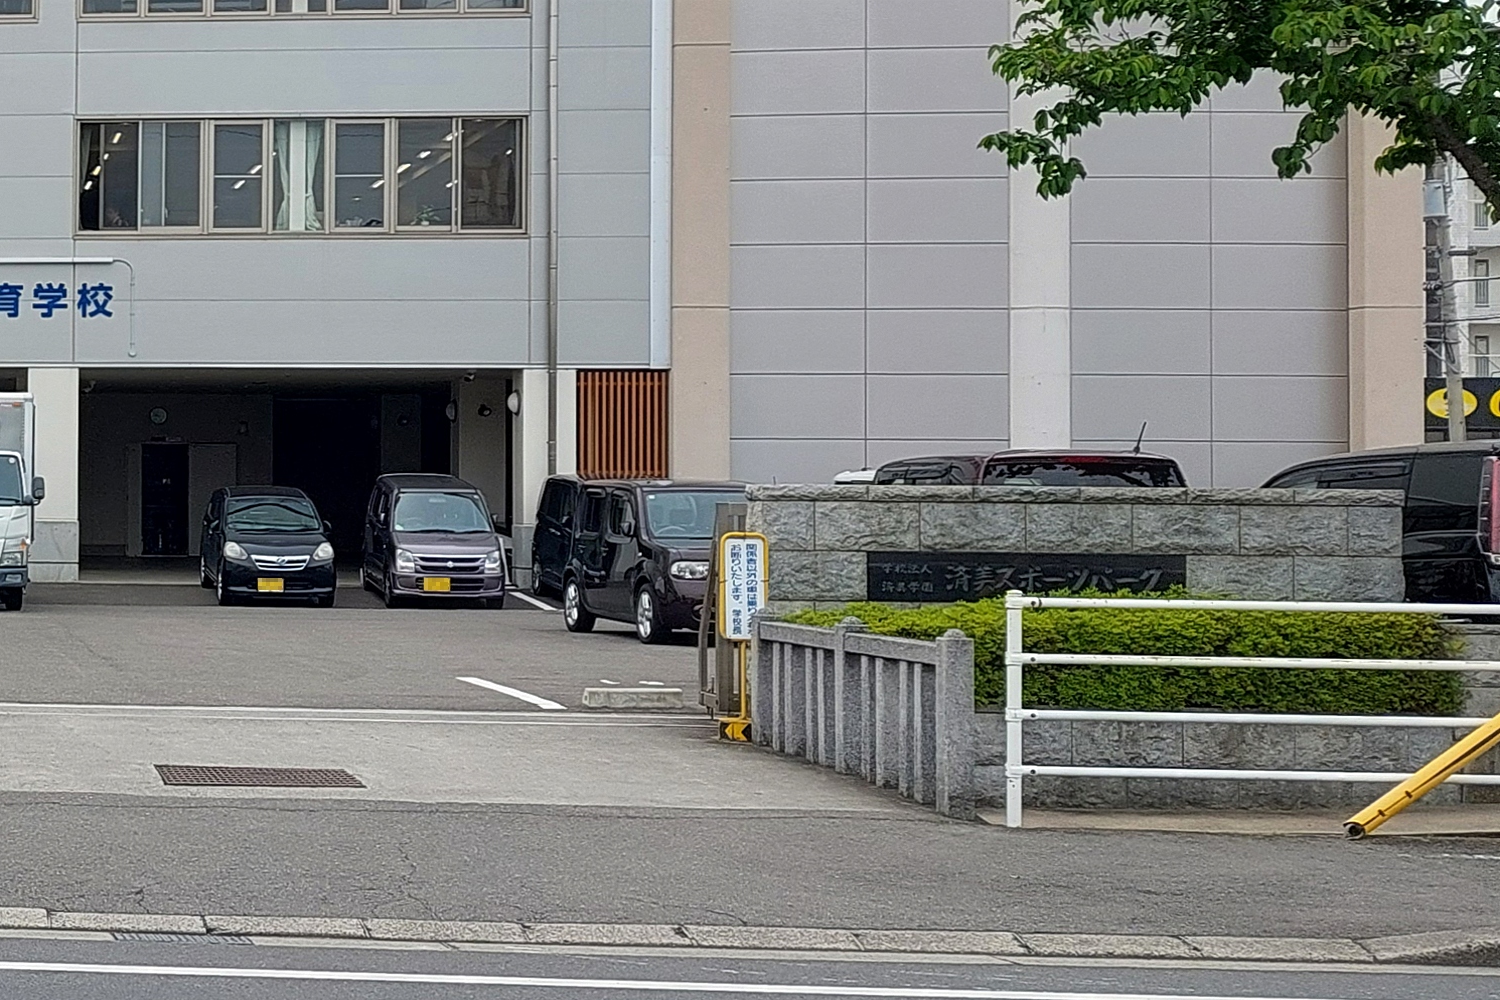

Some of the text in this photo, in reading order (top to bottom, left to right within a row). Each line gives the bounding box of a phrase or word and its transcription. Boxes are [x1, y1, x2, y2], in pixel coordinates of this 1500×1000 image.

[945, 563, 1165, 592] 済美スポーツパーク
